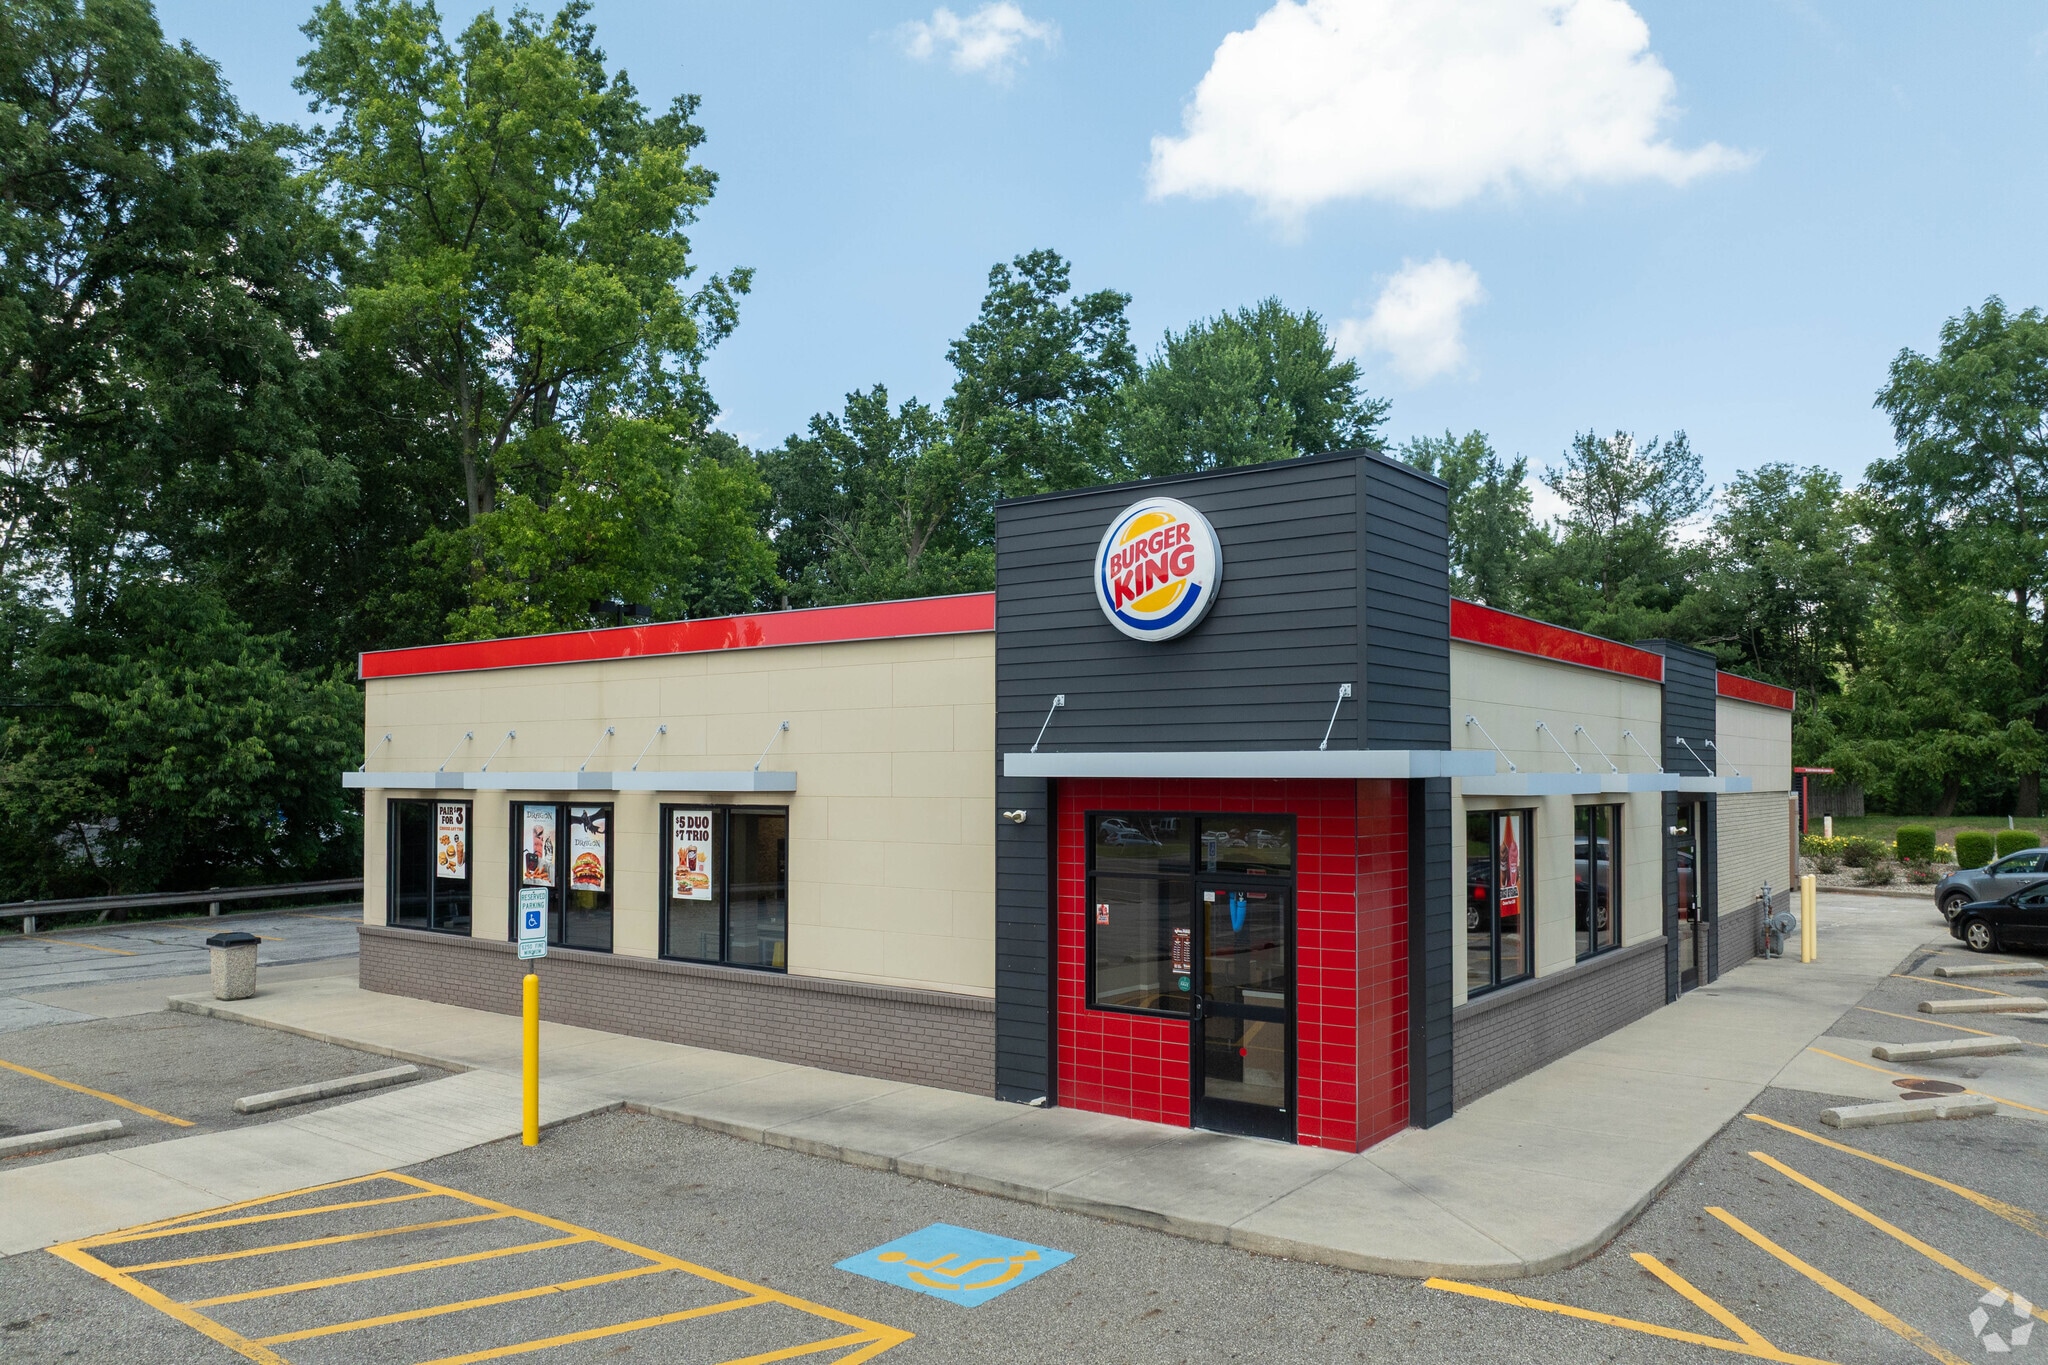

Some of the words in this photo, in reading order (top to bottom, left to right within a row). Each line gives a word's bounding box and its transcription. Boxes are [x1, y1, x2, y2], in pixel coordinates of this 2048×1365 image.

[1110, 522, 1191, 579] BURGER
[1114, 543, 1195, 609] KING
[440, 806, 453, 815] PAIR
[526, 810, 553, 820] DRAGON
[442, 816, 453, 824] FOR
[675, 816, 686, 829] $5
[687, 816, 709, 829] DUO
[675, 829, 684, 841] $7
[686, 830, 709, 841] TRIO
[574, 838, 601, 848] DRAGON
[521, 892, 546, 900] RESERVED
